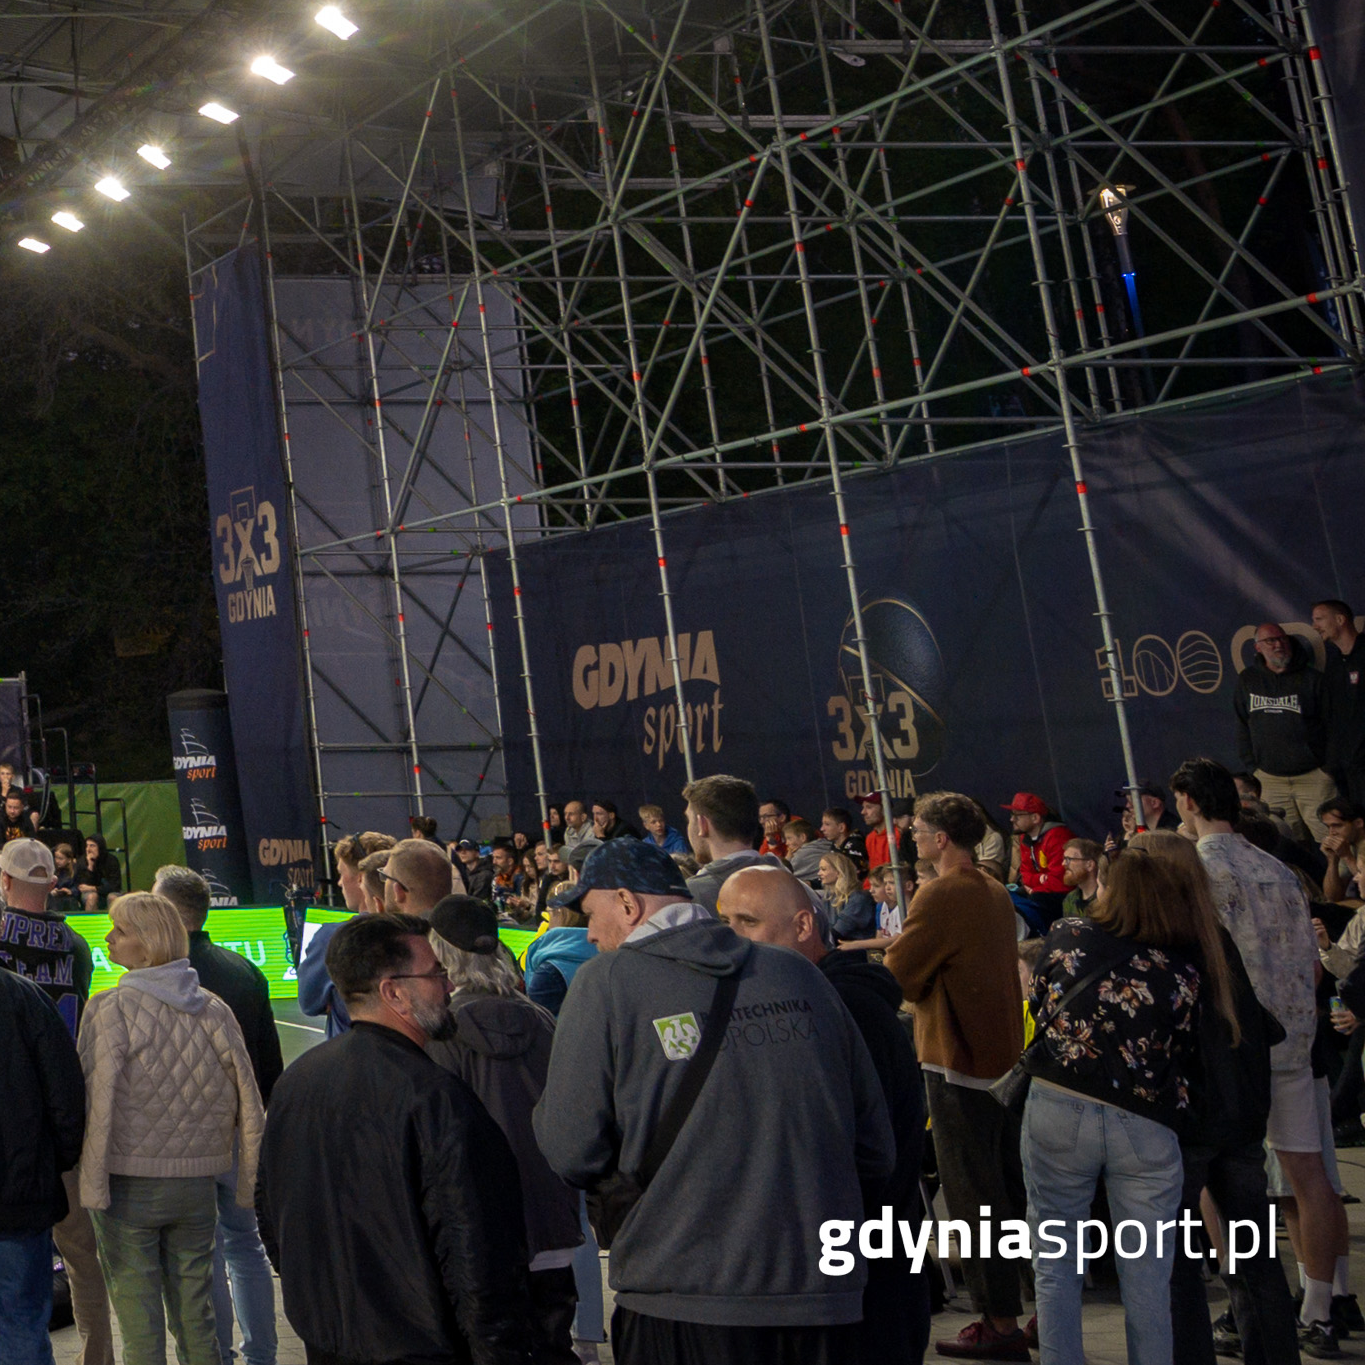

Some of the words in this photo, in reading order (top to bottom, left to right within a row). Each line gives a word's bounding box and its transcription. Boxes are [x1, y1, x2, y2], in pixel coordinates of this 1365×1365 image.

[228, 585, 277, 624] GDYNIA
[572, 630, 721, 710] GDYNIA
[1249, 693, 1300, 713] LONSDALE
[643, 687, 724, 772] sport
[187, 766, 217, 782] sport
[197, 838, 228, 852] sport
[259, 838, 314, 867] GDYNIA
